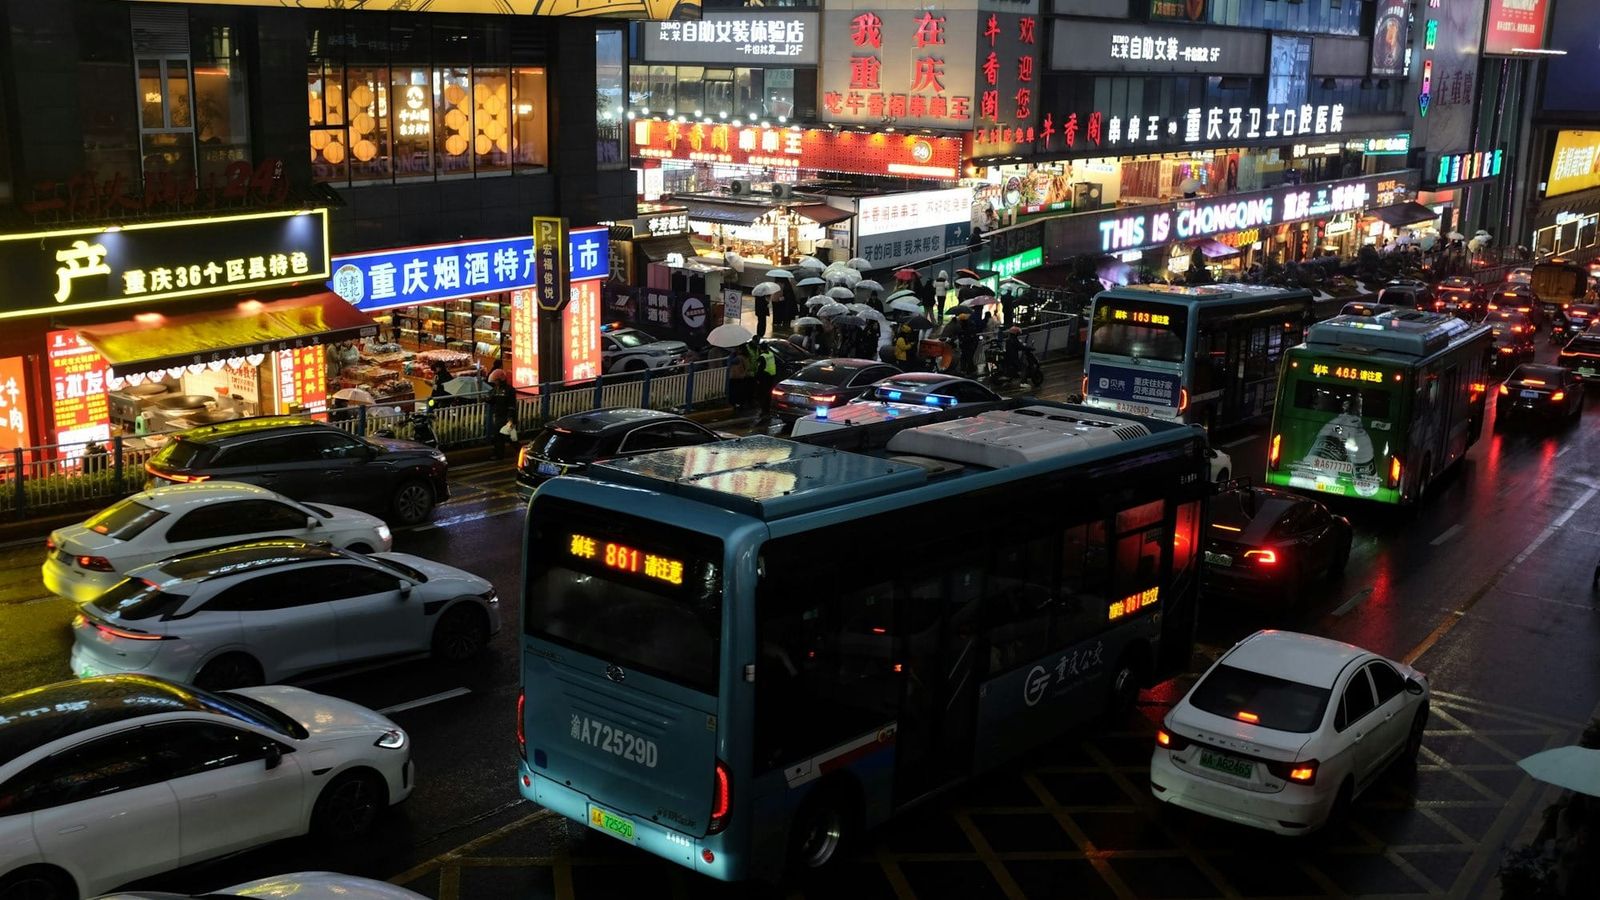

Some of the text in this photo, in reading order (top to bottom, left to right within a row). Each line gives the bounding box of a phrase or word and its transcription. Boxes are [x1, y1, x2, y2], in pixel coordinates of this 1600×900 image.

[682, 20, 804, 43] 自助女装体验店
[790, 44, 803, 56] 2F
[1130, 36, 1179, 61] 自助女装
[849, 55, 945, 93] 重庆
[1015, 17, 1035, 120] 欢迎您
[824, 90, 970, 121] 吃牛香阁串串王
[976, 127, 1035, 145] 不好吃免单
[1185, 103, 1345, 143] 重庆牙卫士口腔医院
[541, 222, 553, 241] P
[1100, 216, 1145, 250] THIS
[1152, 213, 1170, 242] IS
[1177, 197, 1274, 239] CHONGQING
[865, 235, 940, 262] 牙的问题 我来帮您
[54, 240, 112, 304] 产
[123, 252, 310, 295] 重庆36个区县特色
[543, 243, 554, 300] 宏福俊悦
[1132, 311, 1150, 323] 163
[1110, 378, 1126, 389] 贝壳
[1360, 370, 1384, 383] 请注意
[571, 534, 684, 585] 刹车 861 请注意
[570, 714, 658, 769] 渝A72529D
